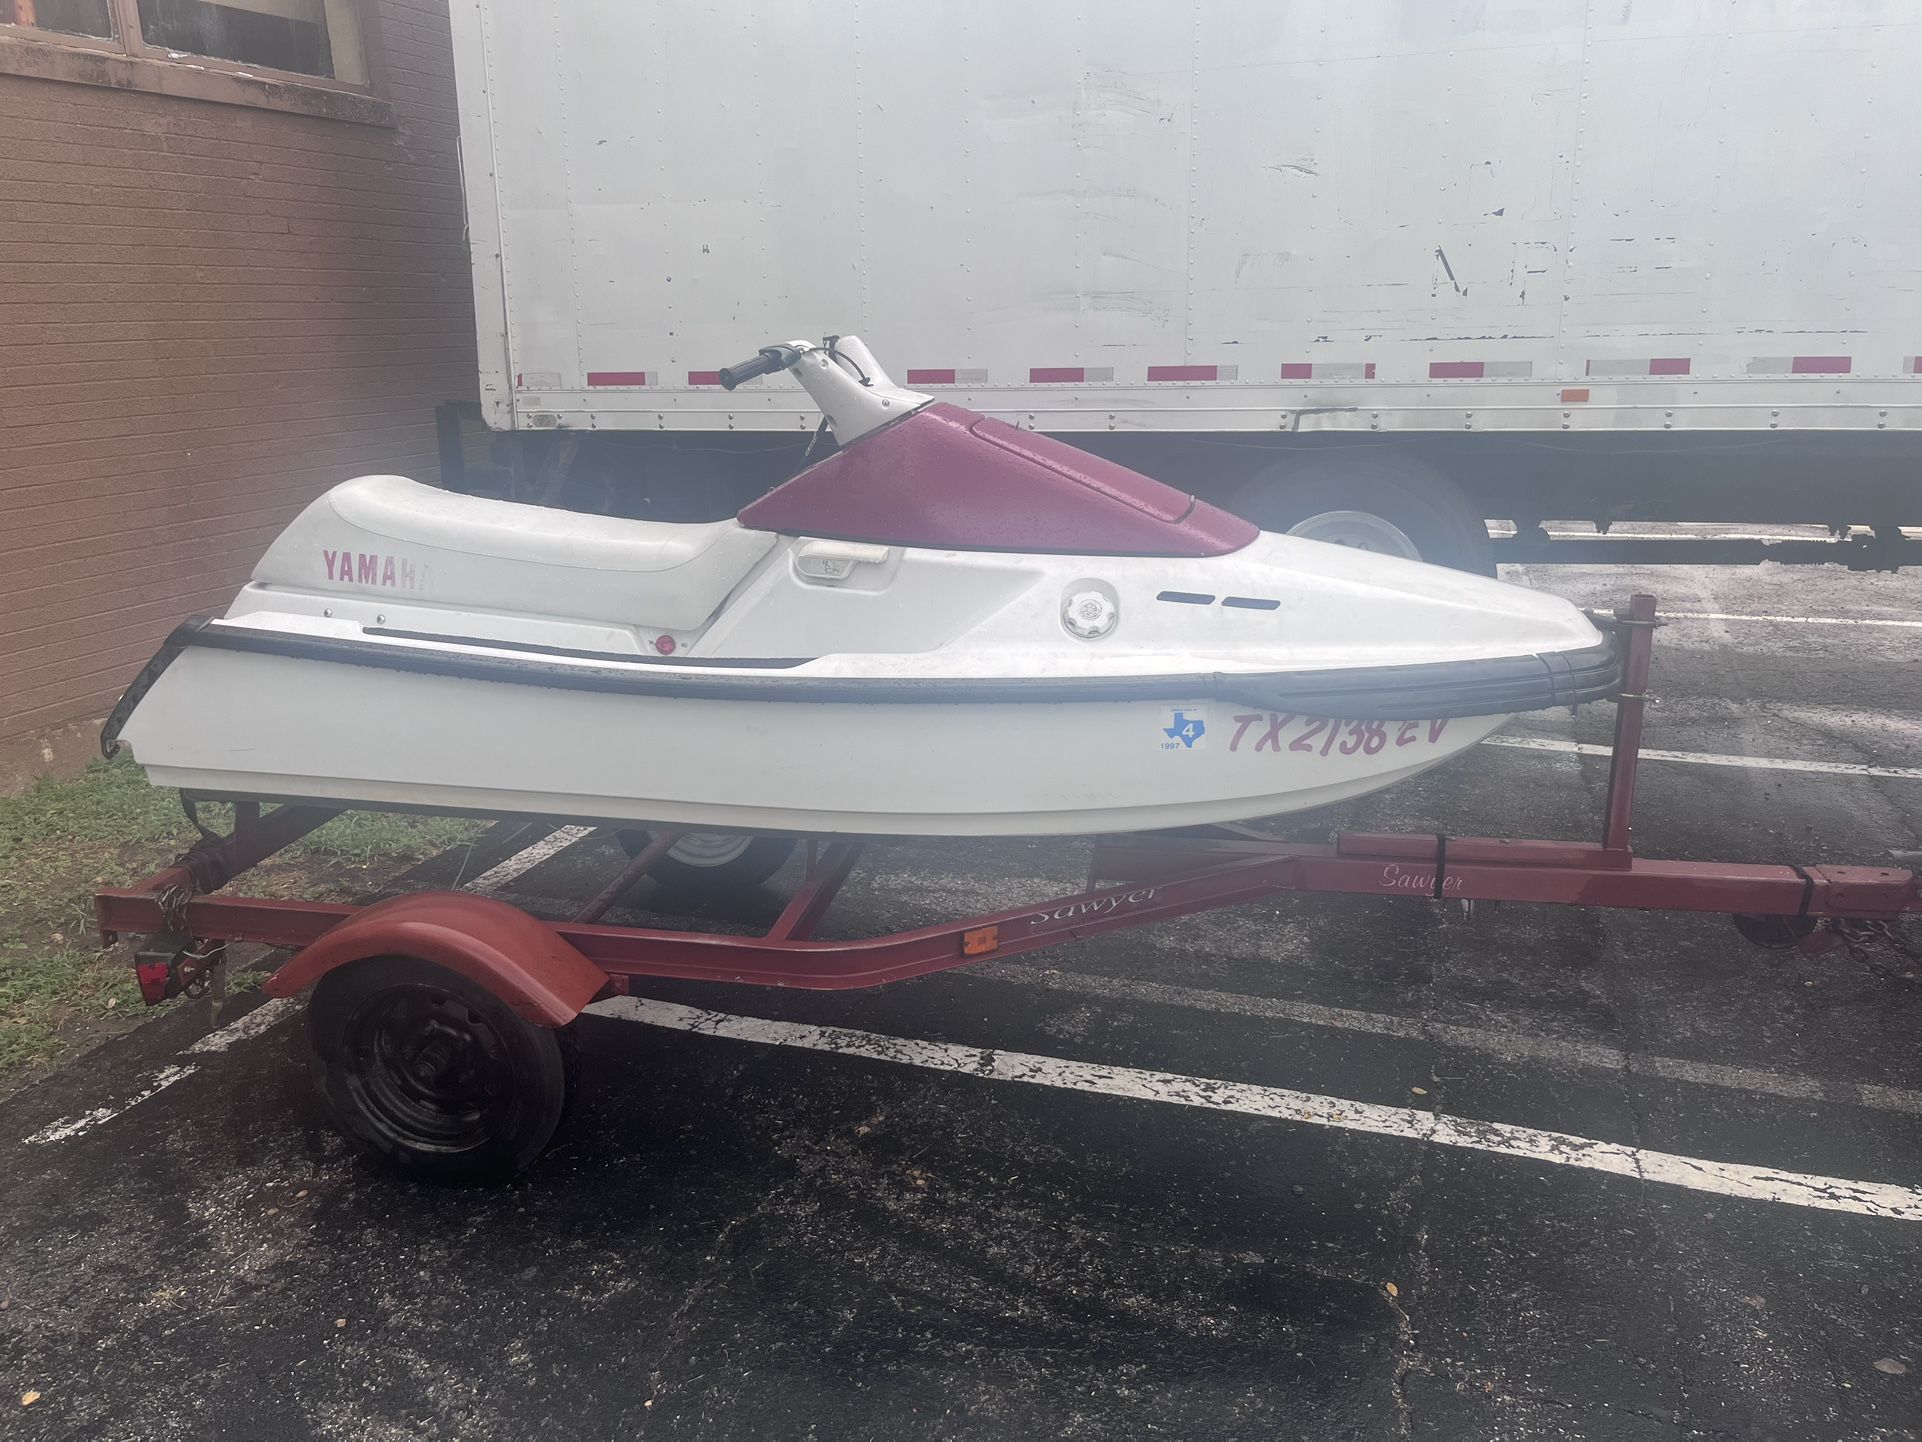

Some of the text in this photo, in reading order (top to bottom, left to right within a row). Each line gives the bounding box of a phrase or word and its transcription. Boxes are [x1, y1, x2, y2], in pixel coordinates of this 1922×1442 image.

[322, 549, 430, 592] YAMAH
[1182, 723, 1195, 738] 4
[1160, 742, 1180, 750] 1997
